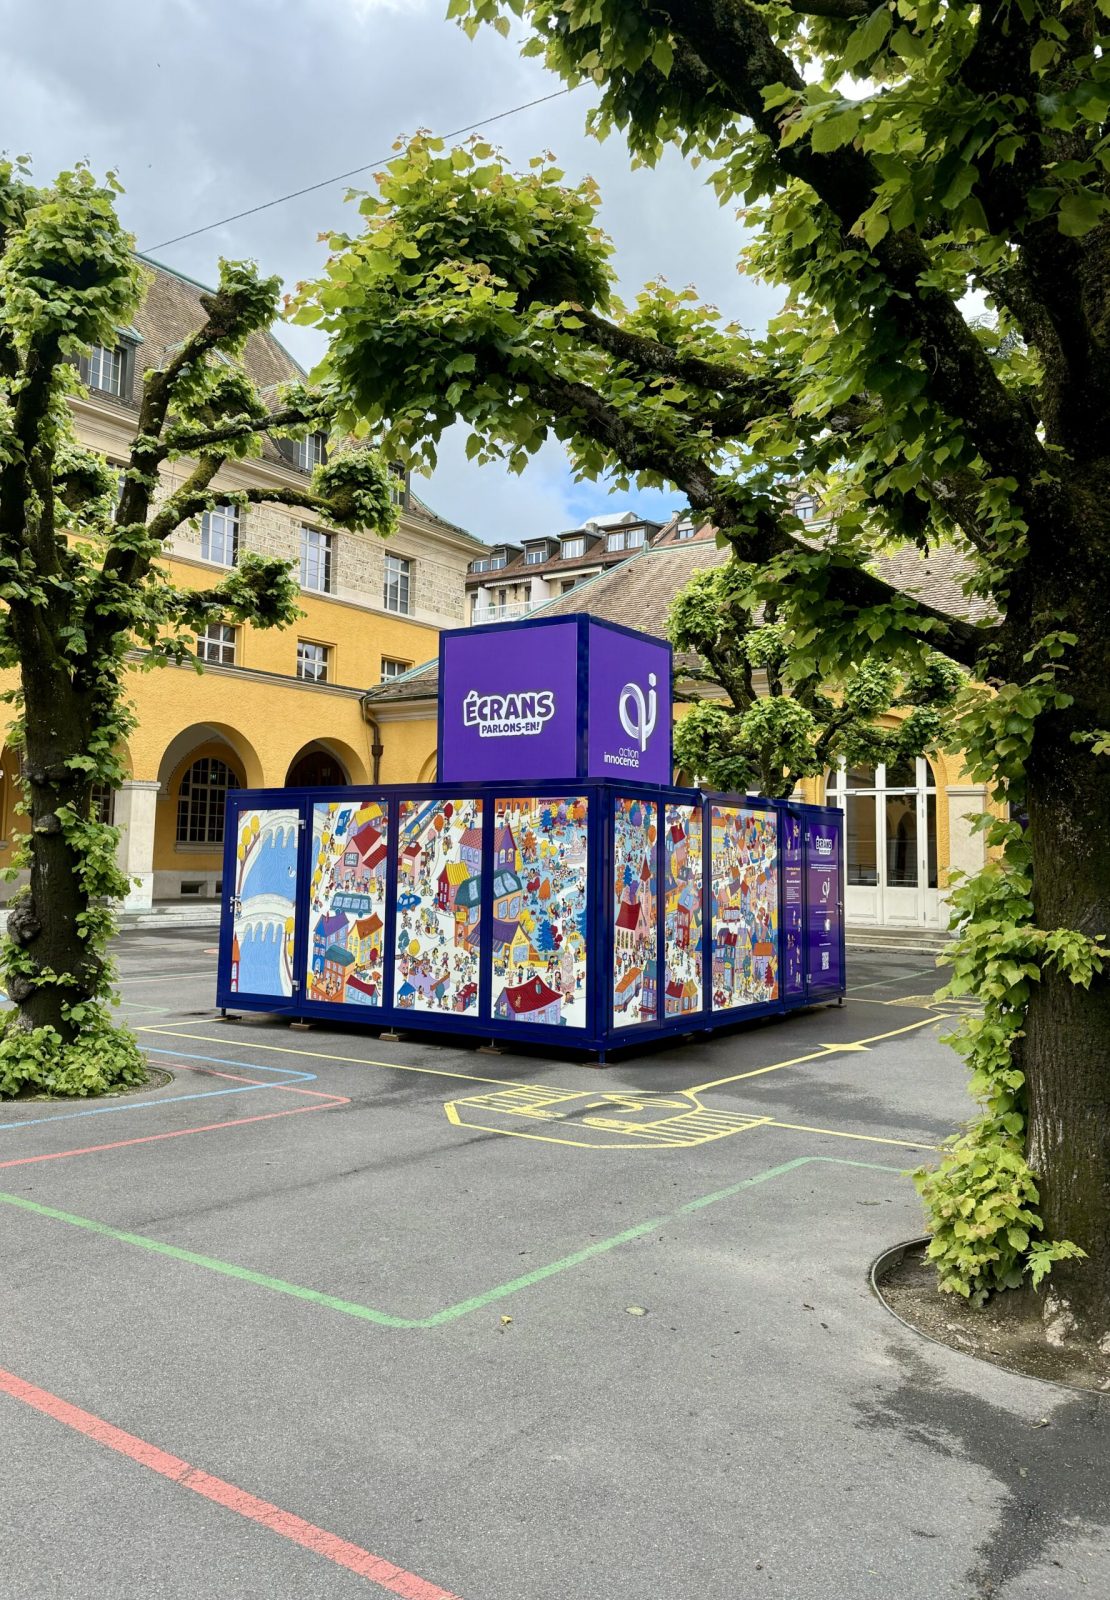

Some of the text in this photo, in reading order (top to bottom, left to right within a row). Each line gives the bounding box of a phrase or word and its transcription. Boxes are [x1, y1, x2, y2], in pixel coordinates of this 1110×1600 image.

[465, 692, 553, 723] ÉCRANS
[481, 721, 541, 735] PARLONS-EN!
[603, 751, 640, 768] innocence
[618, 746, 639, 759] action
